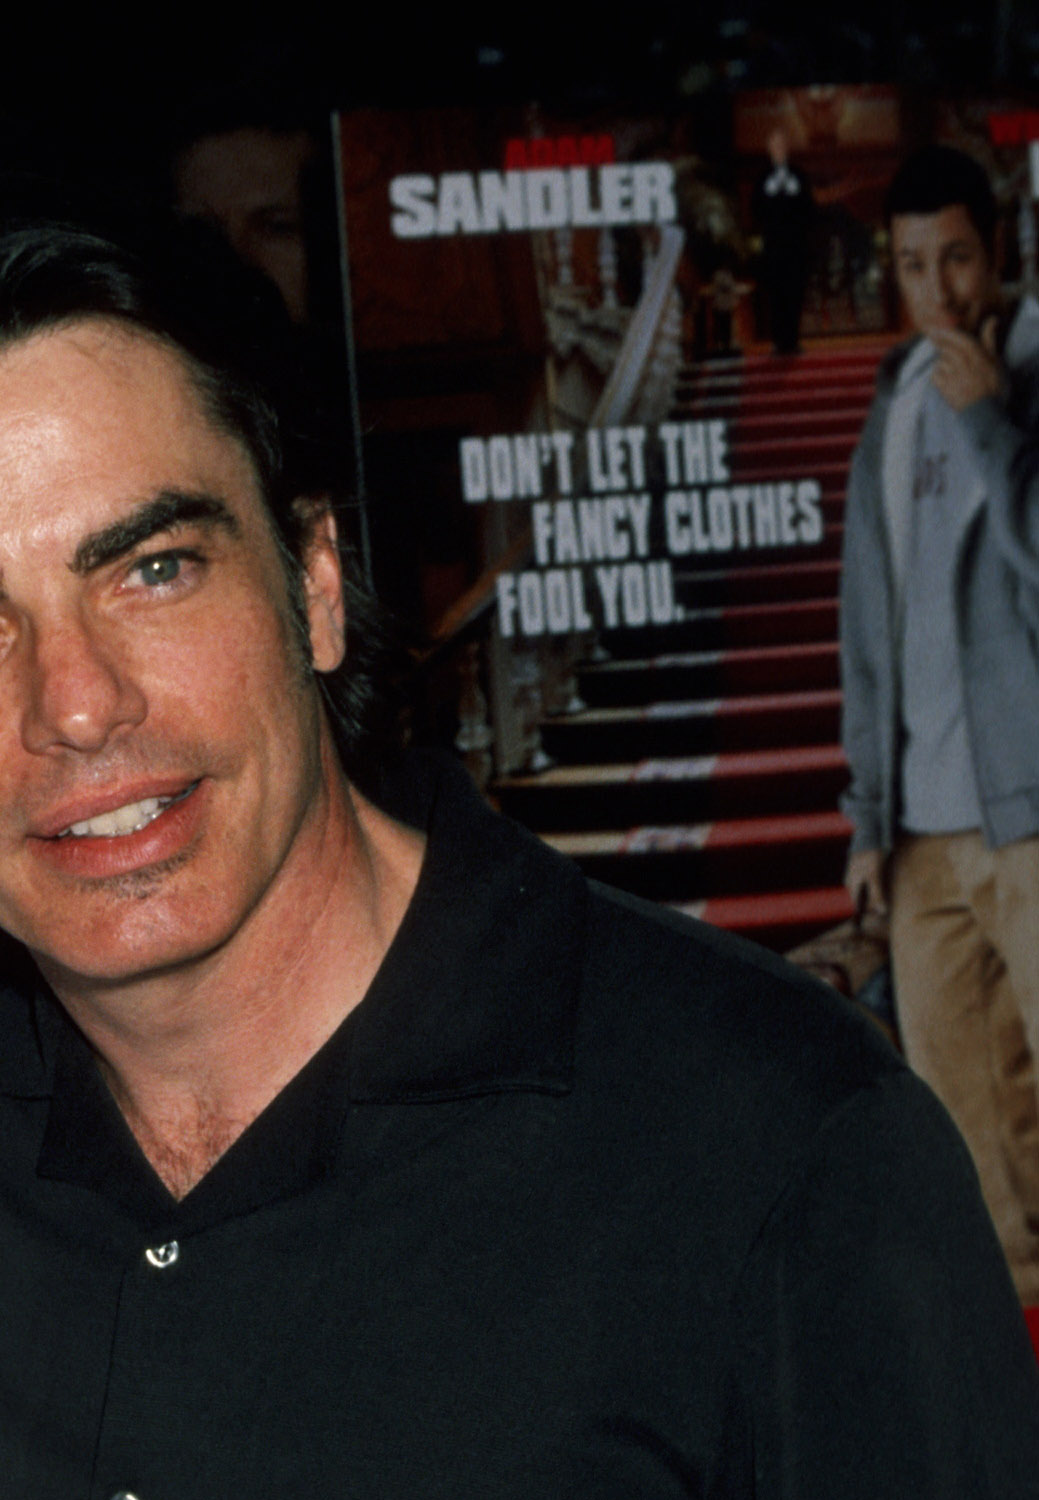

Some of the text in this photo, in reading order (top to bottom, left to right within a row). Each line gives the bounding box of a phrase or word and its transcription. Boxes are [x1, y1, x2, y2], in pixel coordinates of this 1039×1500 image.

[390, 160, 677, 239] SANDLER
[459, 419, 731, 503] DON'T LET THE
[532, 479, 823, 566] FANCY CLOTHES
[496, 559, 686, 638] FOOL YOU.
